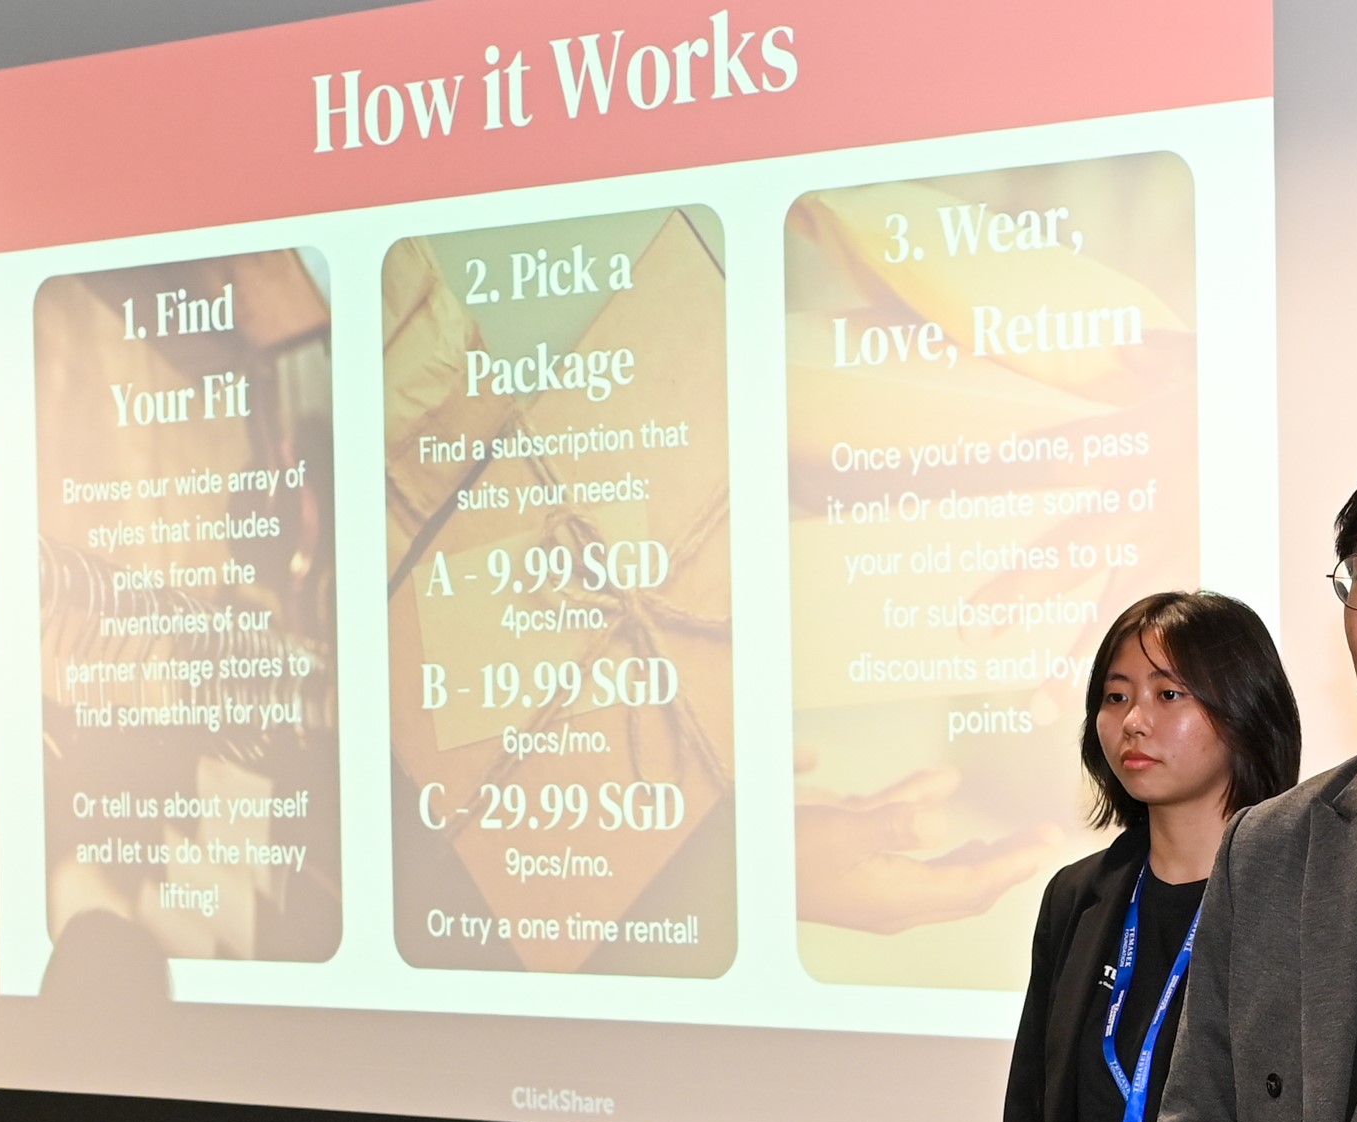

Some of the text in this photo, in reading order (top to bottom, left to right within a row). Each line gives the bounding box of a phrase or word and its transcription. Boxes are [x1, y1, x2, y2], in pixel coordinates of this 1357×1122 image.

[311, 8, 800, 153] How it Works
[884, 202, 1084, 264] 3. Wear,
[465, 244, 634, 305] 2. Pick a
[122, 283, 234, 340] 1. Find
[832, 303, 1144, 369] Love, Return
[465, 342, 635, 402] Package
[110, 372, 251, 427] Your Fit
[419, 419, 689, 464] Find a subscription that
[831, 442, 901, 472] Once
[999, 432, 1075, 465] done,
[1082, 431, 1150, 466] pass
[62, 460, 305, 504] Browse our wide array of
[456, 472, 650, 515] suits your needs:
[826, 479, 1157, 525] it on! Or donate some of
[88, 511, 280, 554] styles that includes
[113, 559, 256, 599] picks from the
[425, 550, 455, 597] A
[487, 545, 573, 596] 9.99
[582, 540, 669, 592] SGD
[844, 541, 1139, 583] your old clothes to us
[99, 605, 272, 637] inventories of our
[500, 600, 608, 638] 4pcs/mo.
[883, 594, 1098, 635] for subscription
[66, 653, 310, 690] partner vintage stores to
[421, 663, 448, 710] B
[480, 661, 582, 709] 19.99
[591, 657, 679, 707] SGD
[848, 652, 977, 683] discounts
[986, 649, 1037, 681] and
[75, 702, 111, 727] find
[118, 698, 220, 732] something
[225, 697, 253, 724] for
[948, 704, 1033, 741] points
[502, 723, 611, 760] 6pcs/mo.
[73, 790, 309, 824] Or tell us about yourself
[419, 782, 446, 830] C
[479, 783, 589, 831] 29.99
[598, 781, 685, 831] SGD
[76, 837, 306, 872] and let us do the heavy
[505, 846, 613, 883] 9pcs/mo.
[160, 883, 219, 917] lifting!
[427, 908, 698, 945] Or try a one time rental!
[511, 1086, 615, 1115] ClickShare
